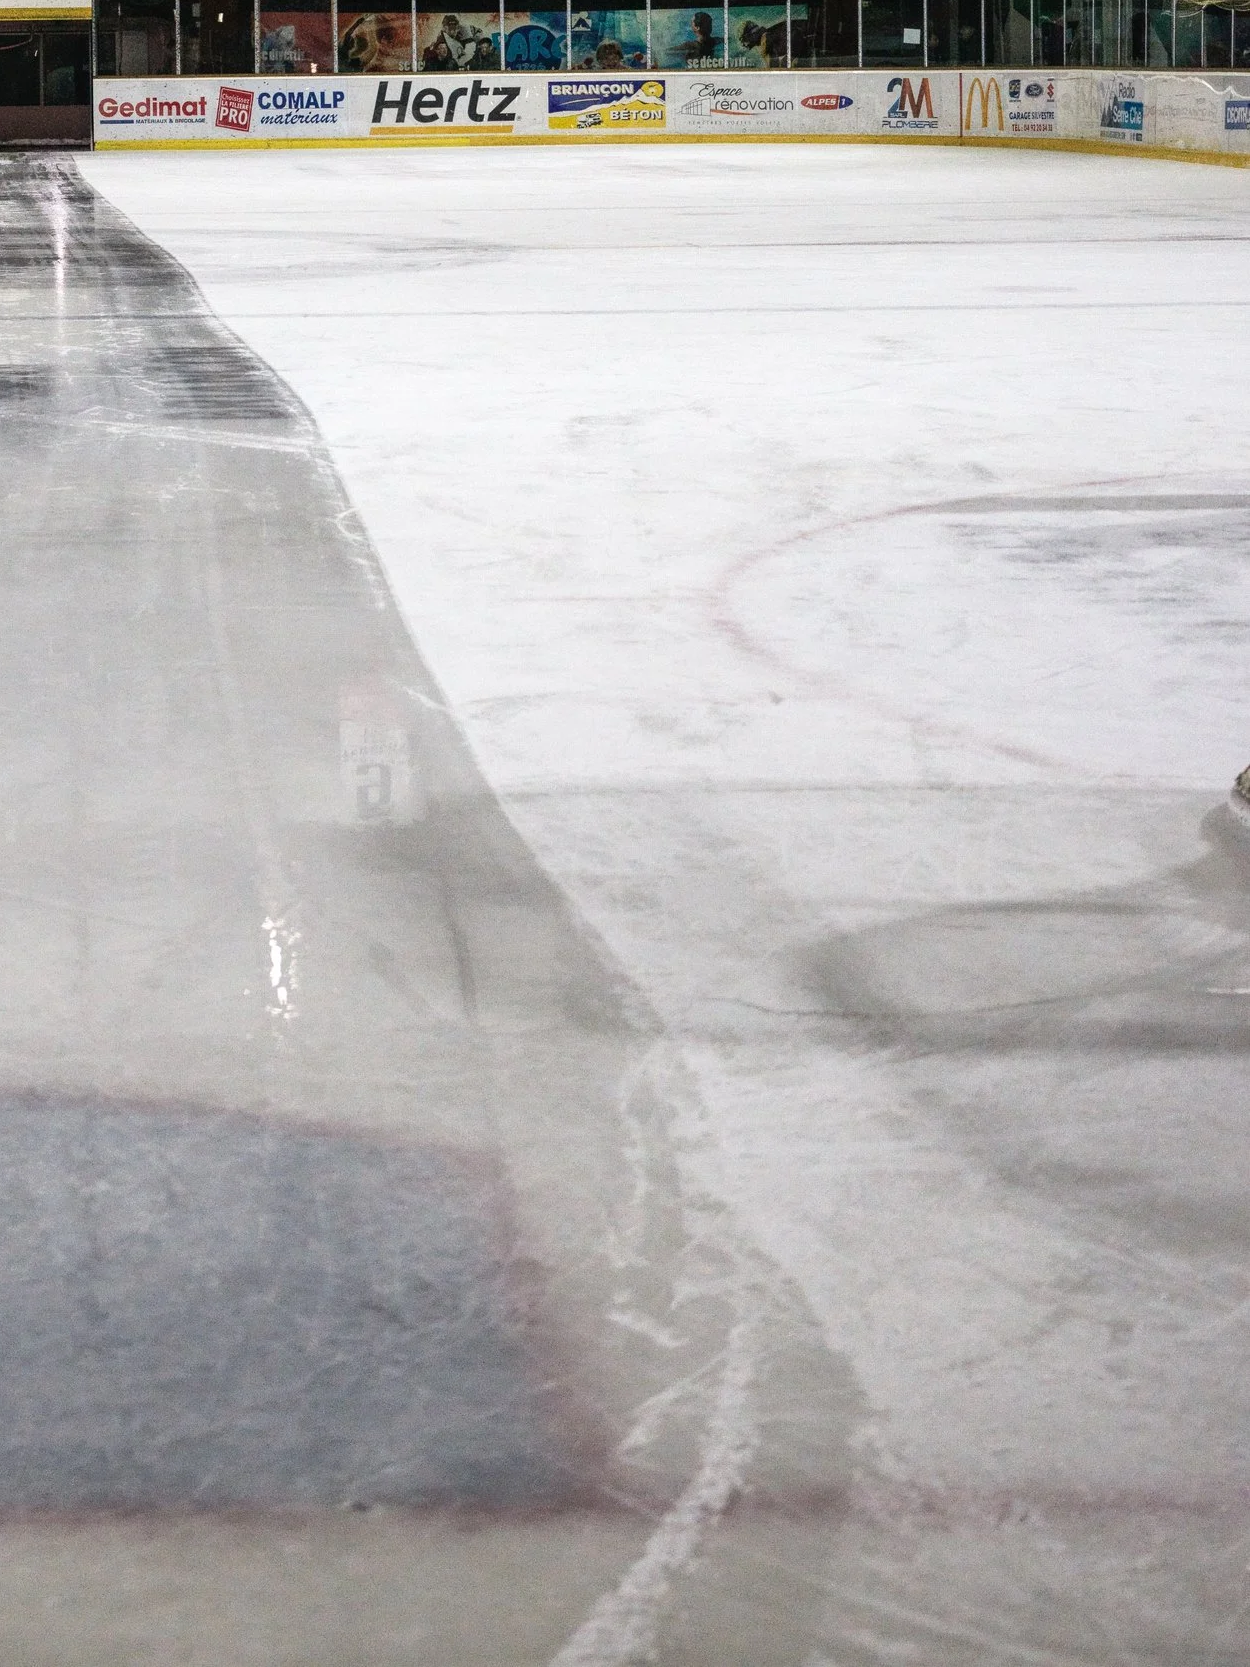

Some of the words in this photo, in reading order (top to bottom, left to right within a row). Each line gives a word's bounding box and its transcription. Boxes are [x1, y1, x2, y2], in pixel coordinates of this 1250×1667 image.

[551, 83, 634, 97] BRIANÇON
[690, 82, 743, 100] Espace
[887, 77, 934, 118] 2M
[1118, 82, 1136, 98] Radio
[222, 93, 250, 104] Choisissez
[258, 91, 345, 109] COMALP
[371, 79, 521, 123] Hertz
[715, 97, 794, 111] rénovation
[805, 98, 836, 106] ALPES
[98, 97, 207, 117] Gedimat
[610, 108, 663, 120] BÉTON
[219, 107, 249, 125] PRO
[260, 109, 338, 124] matériaux
[1009, 112, 1031, 120] GARAGE
